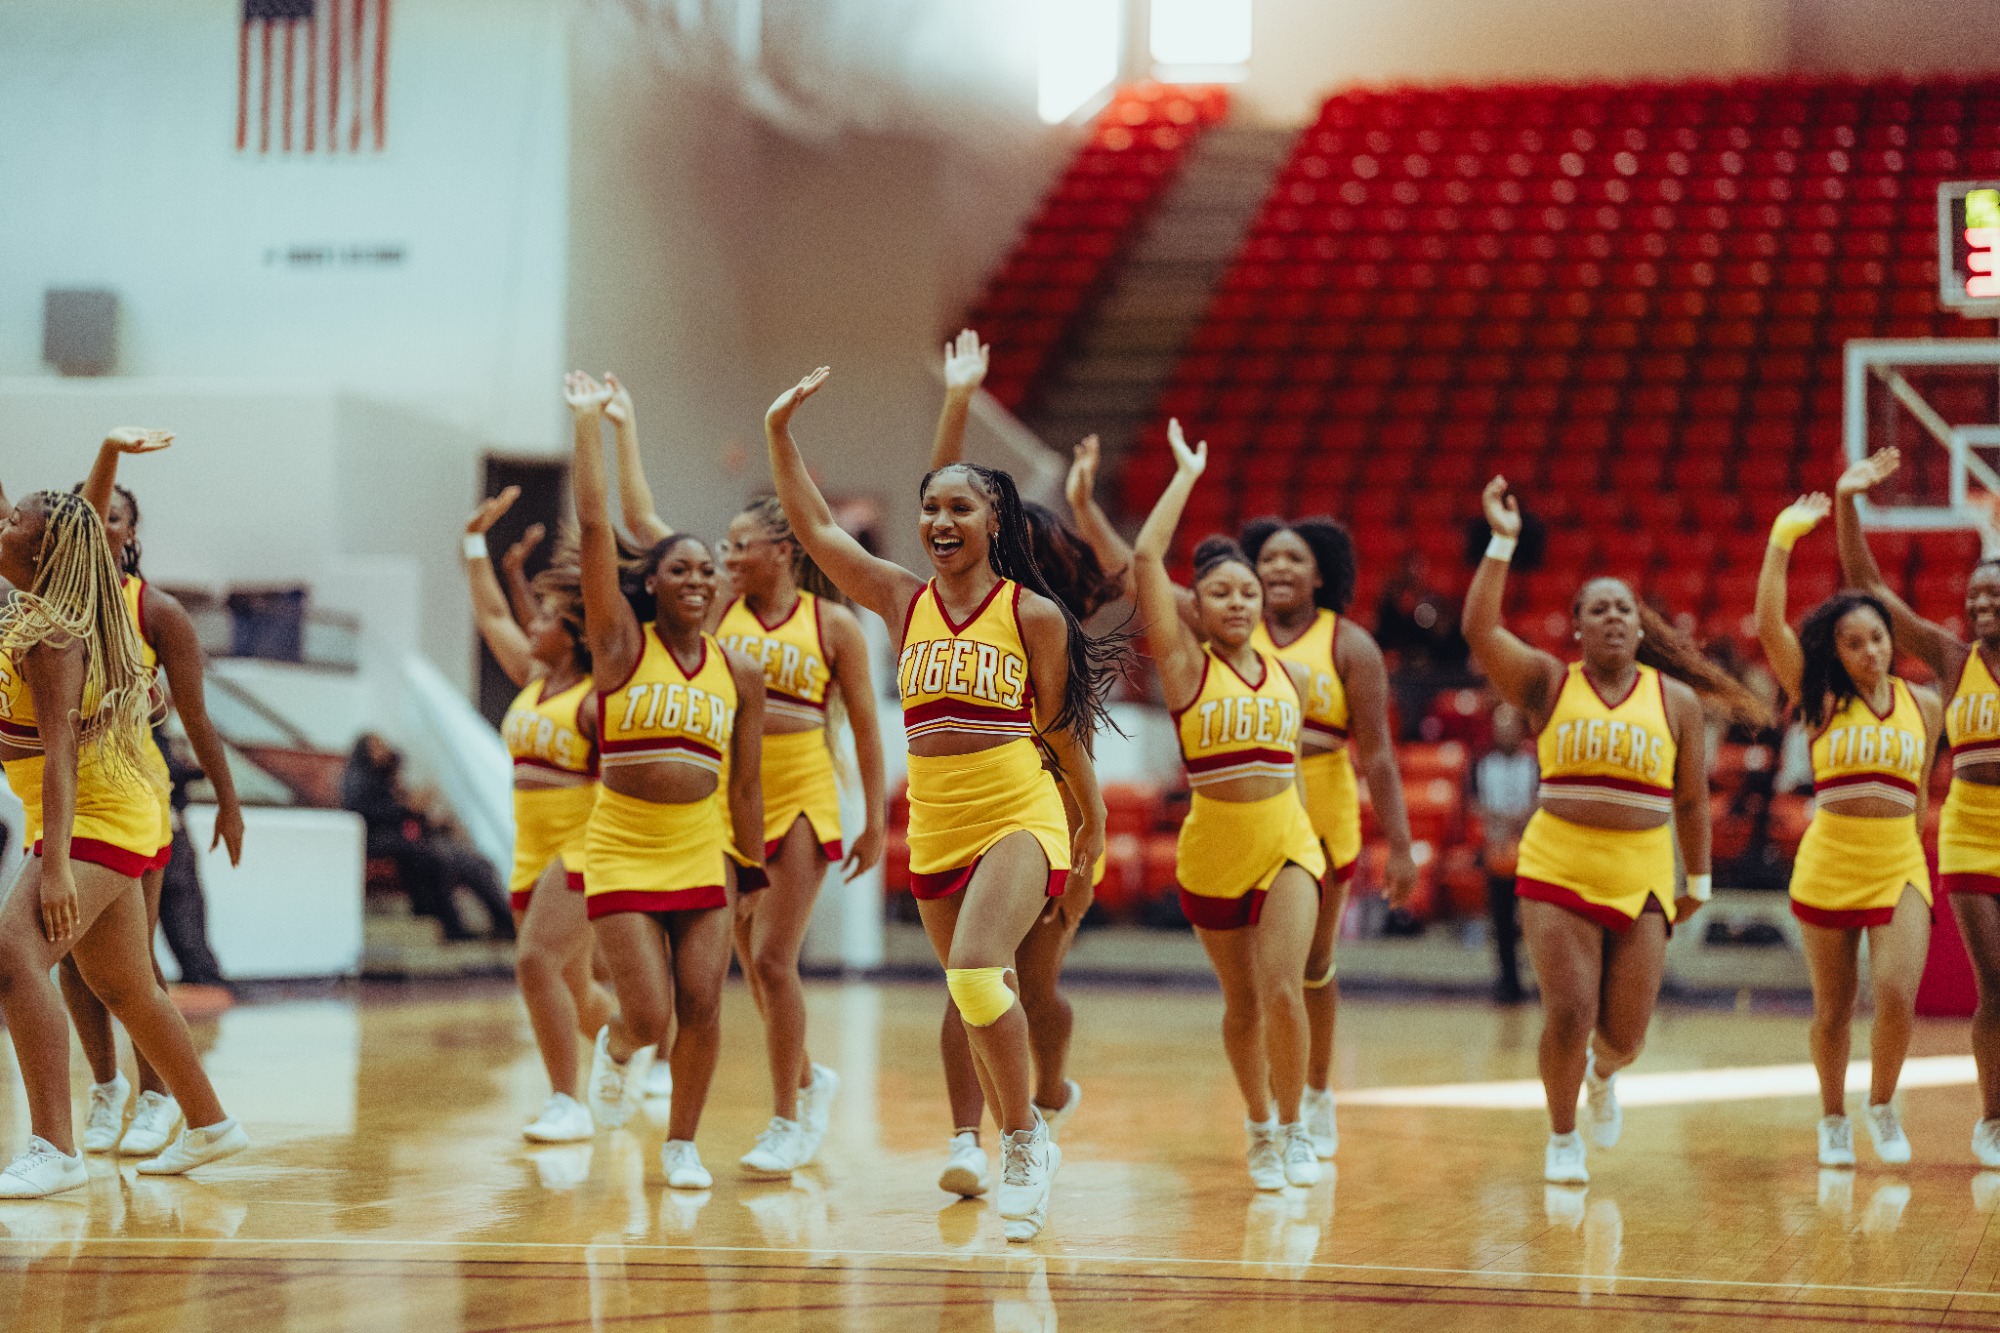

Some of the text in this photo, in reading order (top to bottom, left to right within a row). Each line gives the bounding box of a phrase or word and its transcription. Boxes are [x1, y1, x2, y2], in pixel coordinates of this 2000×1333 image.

[898, 638, 1024, 708] TIGERS
[1951, 692, 2000, 738] TIG
[1556, 718, 1664, 779] TIGERS
